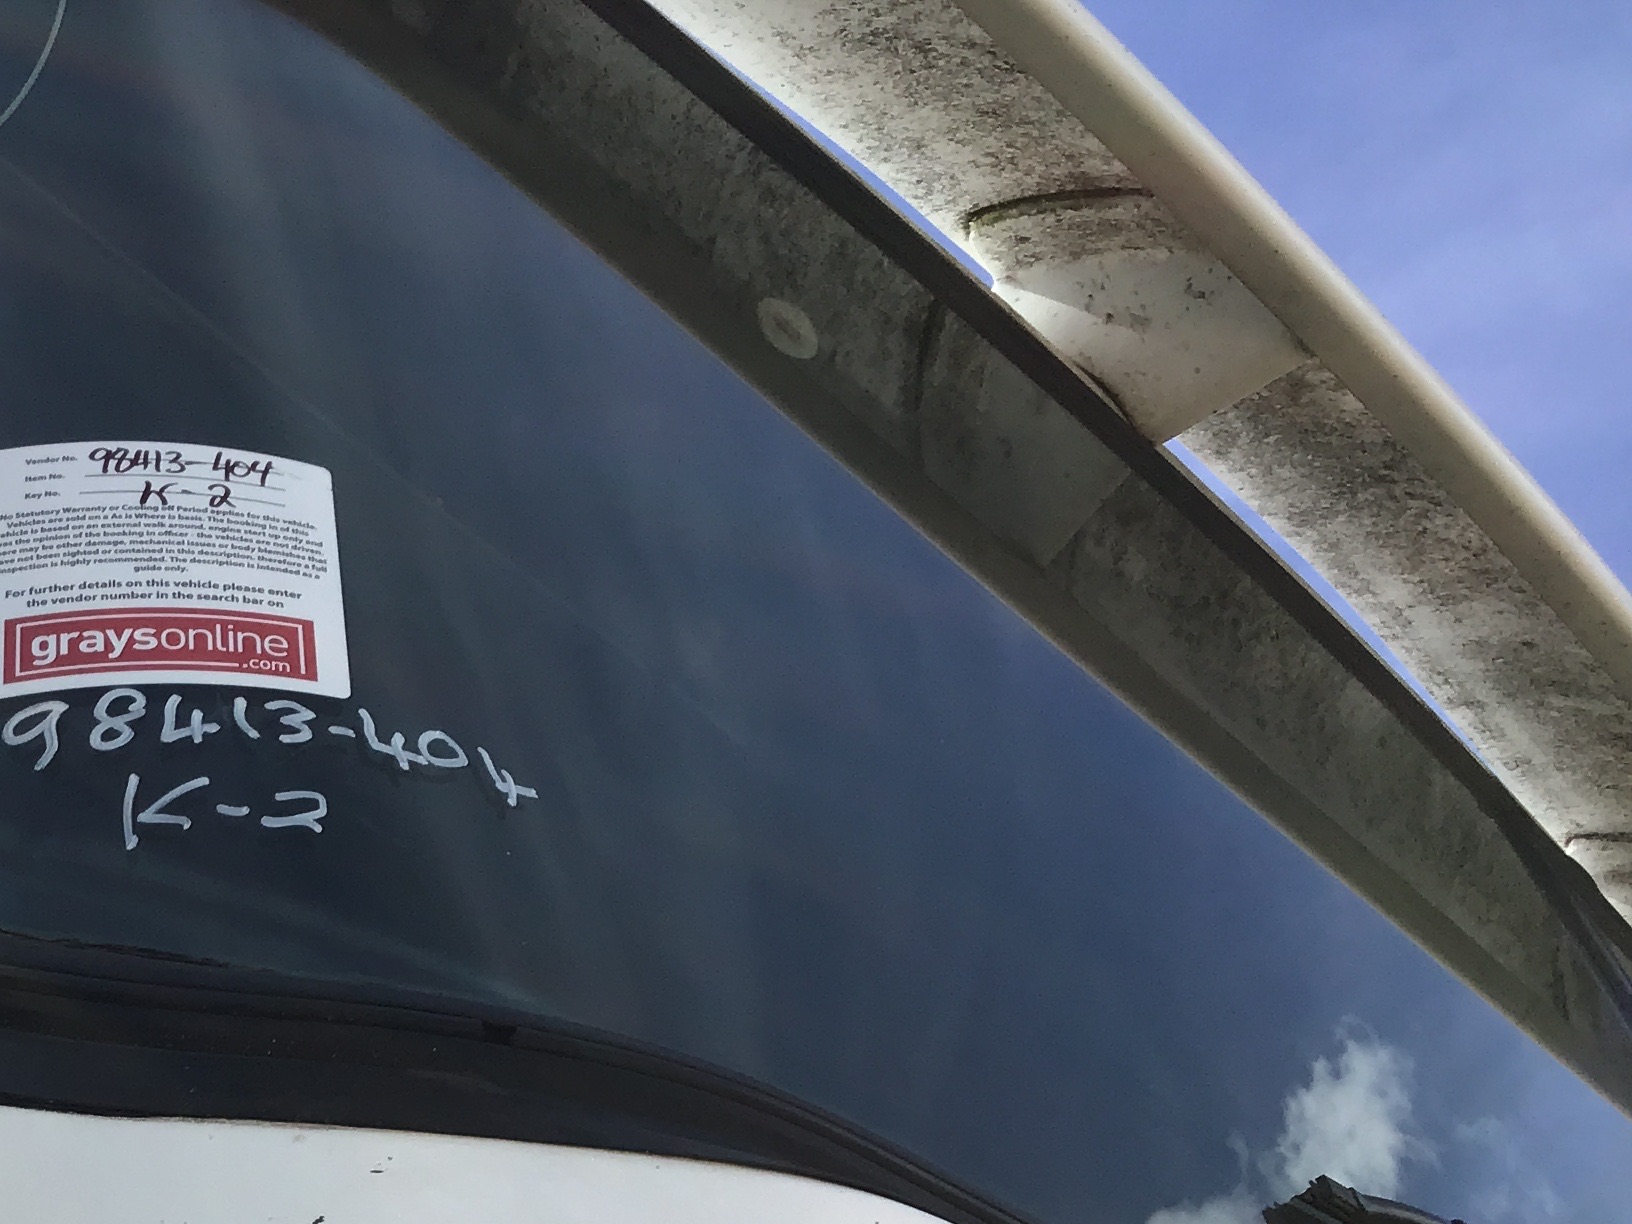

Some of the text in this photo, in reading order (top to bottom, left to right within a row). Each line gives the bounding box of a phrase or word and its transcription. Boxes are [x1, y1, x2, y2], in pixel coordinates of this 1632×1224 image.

[25, 457, 60, 465] Vendor
[88, 447, 274, 487] 98413-404
[24, 492, 42, 500] Key
[5, 578, 302, 600] For further details on this vehicle please enter
[27, 589, 285, 608] the vendor number in the search bar on
[31, 623, 289, 666] graysonline
[1, 688, 539, 808] 98413-404
